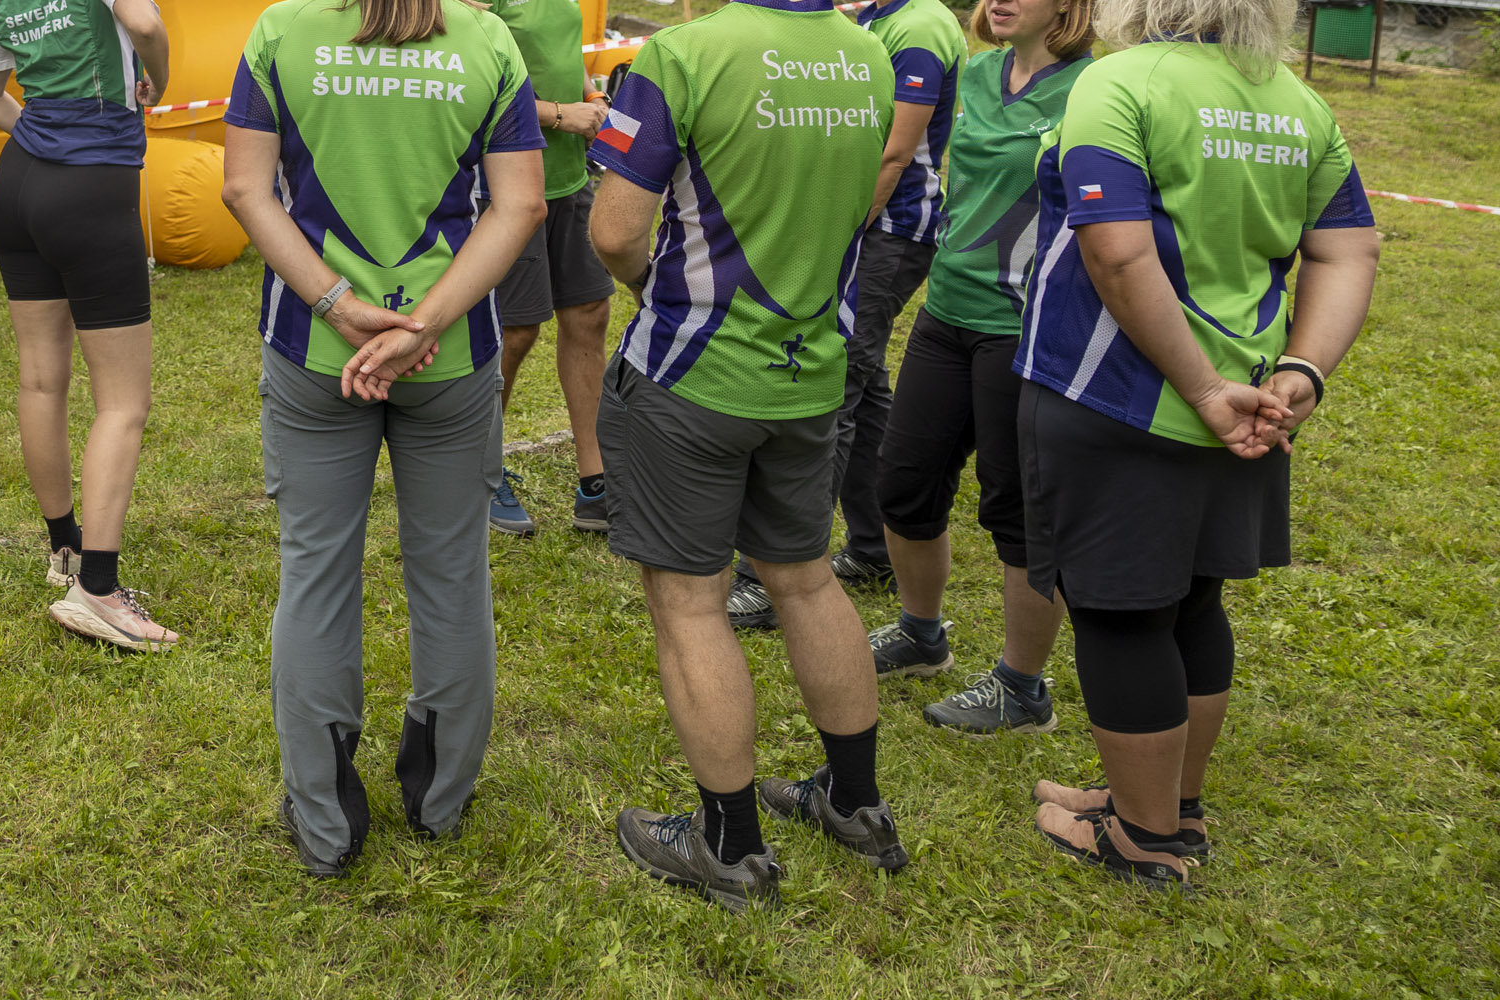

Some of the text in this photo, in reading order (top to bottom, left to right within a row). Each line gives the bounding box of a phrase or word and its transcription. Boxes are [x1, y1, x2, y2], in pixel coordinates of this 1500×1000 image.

[315, 45, 465, 74] SEVERKA
[762, 49, 871, 82] Severka
[312, 72, 467, 104] ŠUMPERK
[756, 90, 880, 137] Šumperk
[1198, 107, 1308, 138] SEVERKA
